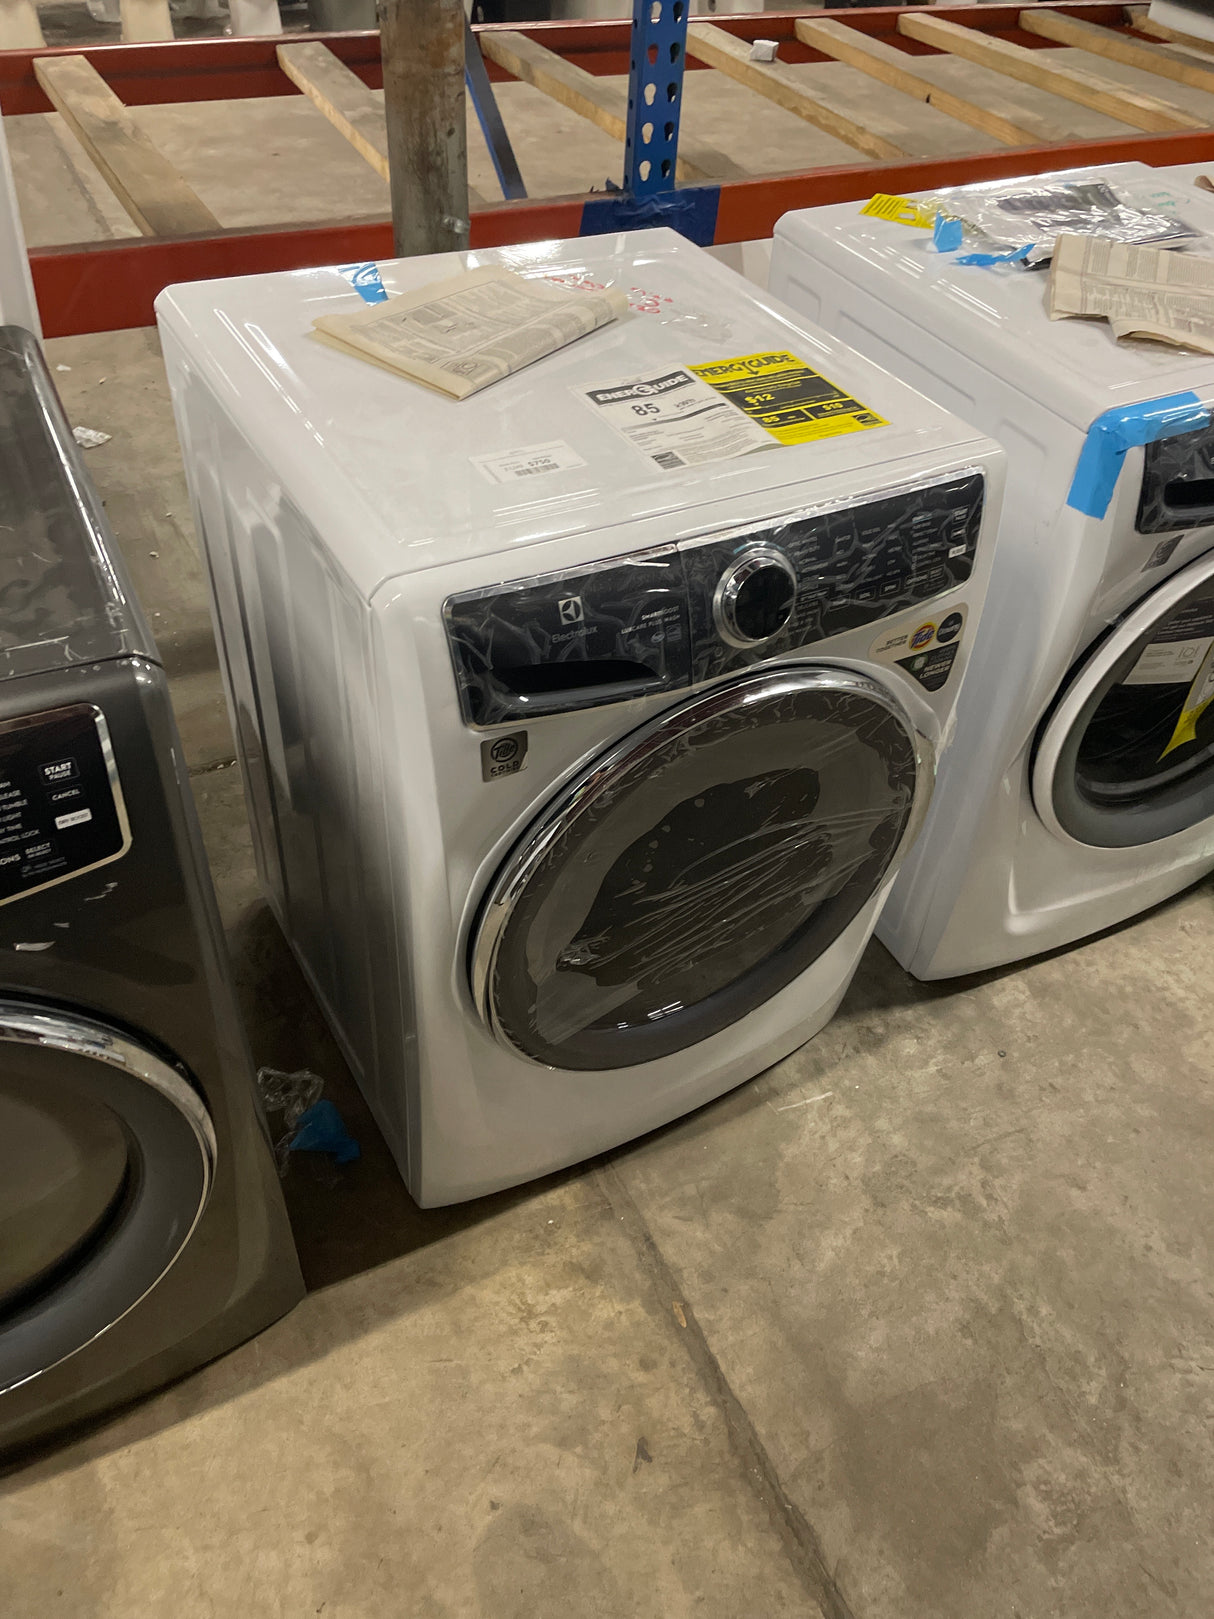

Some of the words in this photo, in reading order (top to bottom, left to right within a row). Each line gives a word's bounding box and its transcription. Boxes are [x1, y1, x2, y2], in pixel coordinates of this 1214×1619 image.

[631, 402, 660, 416] 85
[551, 626, 598, 644] Electrolux
[911, 628, 935, 649] Tide
[44, 761, 72, 775] START
[490, 760, 520, 774] COLD
[51, 788, 81, 801] CANCEL
